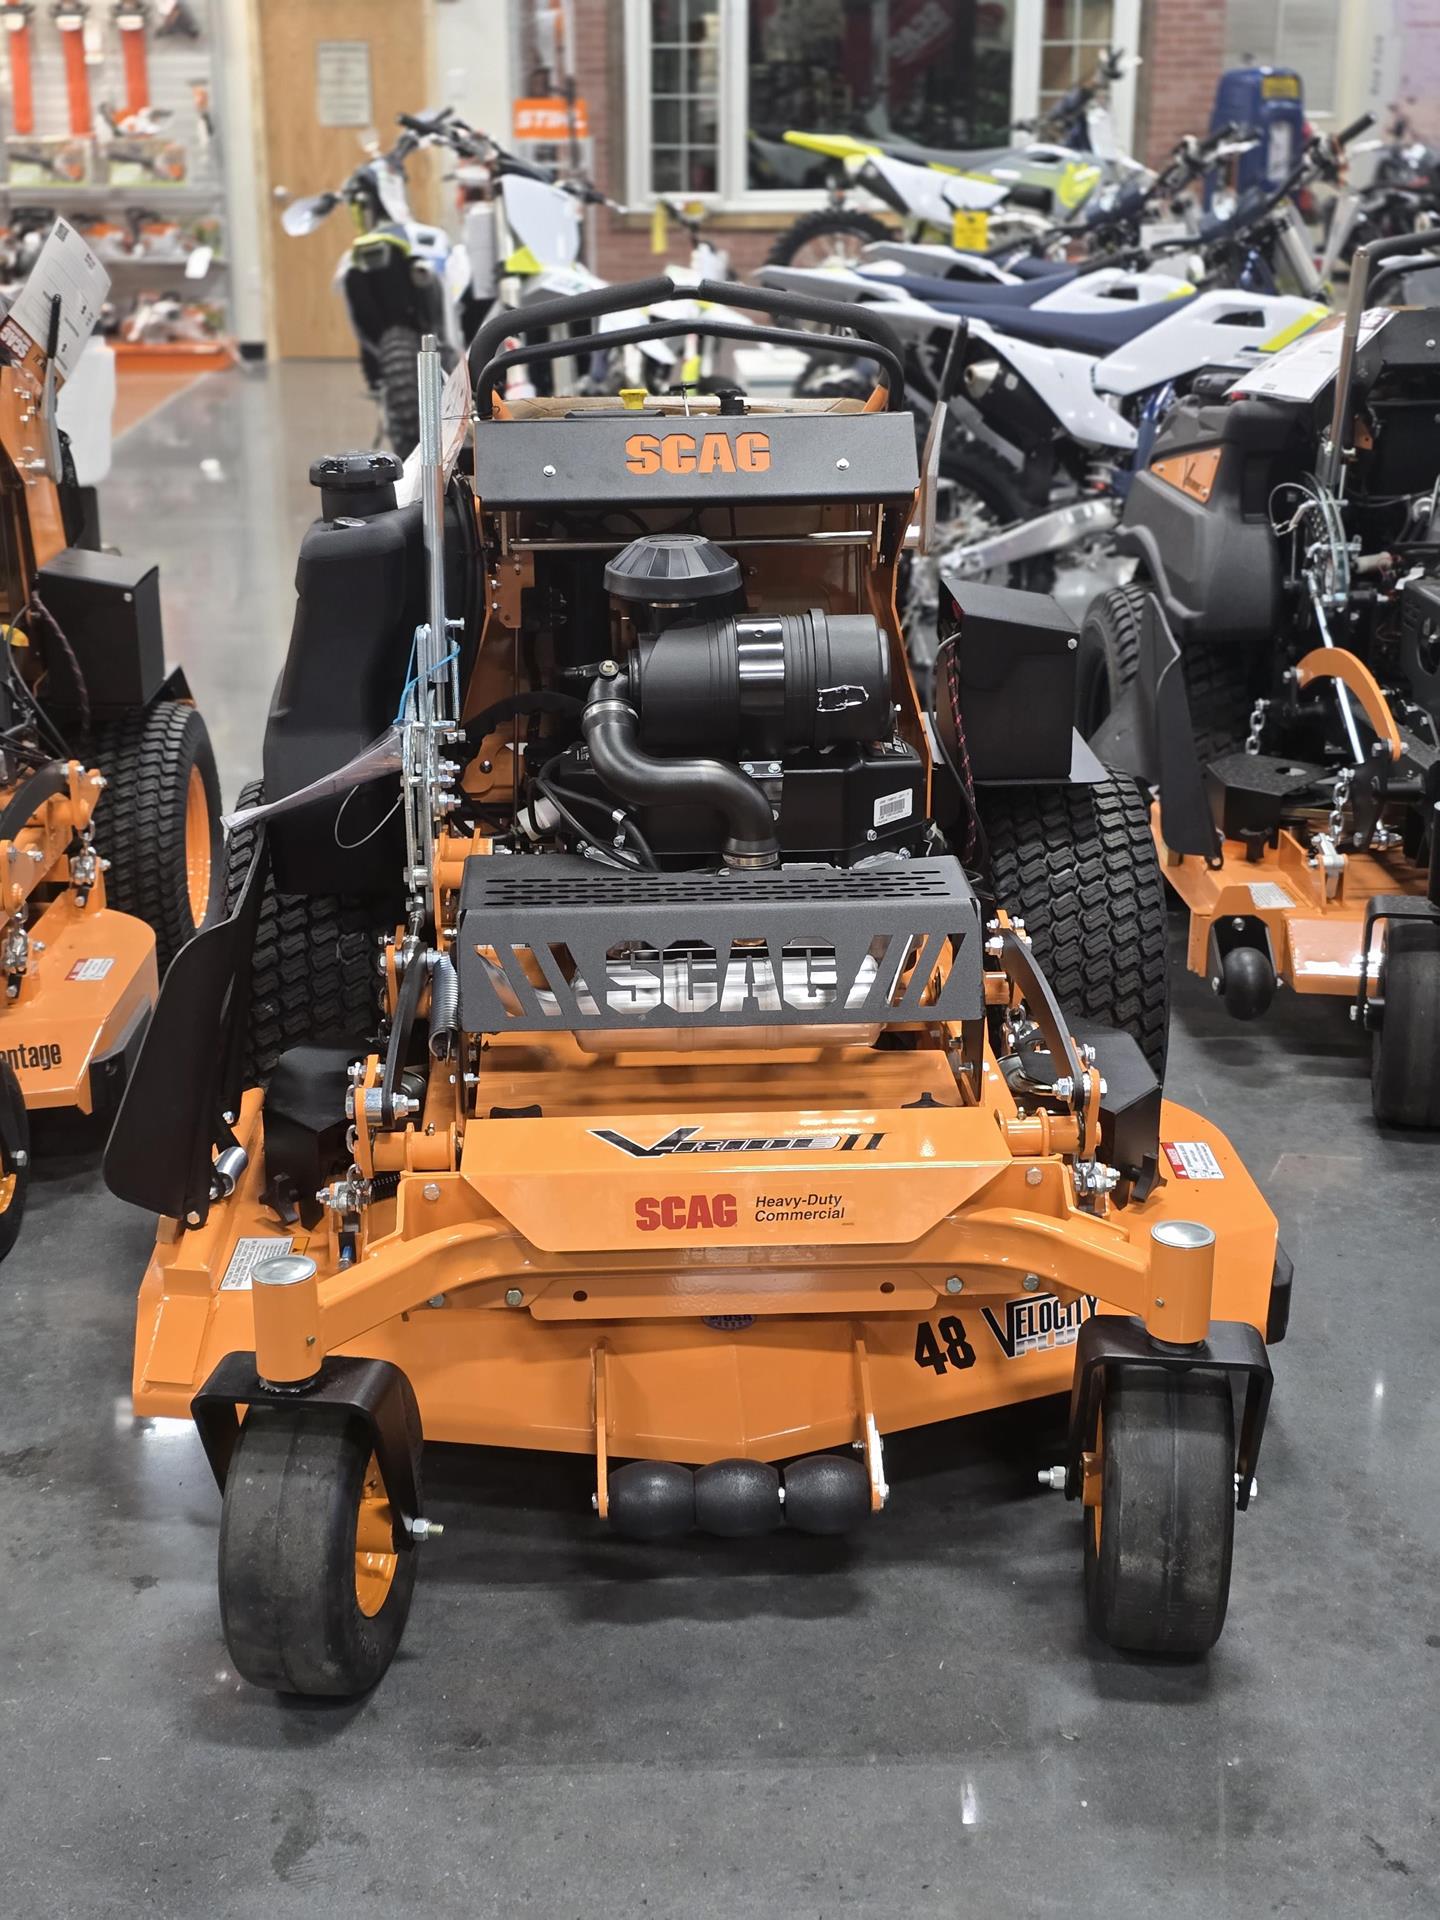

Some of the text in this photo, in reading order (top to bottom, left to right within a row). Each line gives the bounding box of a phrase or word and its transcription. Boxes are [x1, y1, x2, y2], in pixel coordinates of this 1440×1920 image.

[625, 431, 771, 475] SCAG
[606, 936, 837, 1015] SCAG
[634, 1194, 738, 1231] SCAG
[754, 1207, 845, 1222] Commercial
[755, 1193, 843, 1209] Heavy-Duty
[914, 1315, 977, 1376] 48
[980, 1292, 1098, 1359] VELOCITY
[1015, 1329, 1078, 1356] PLU
